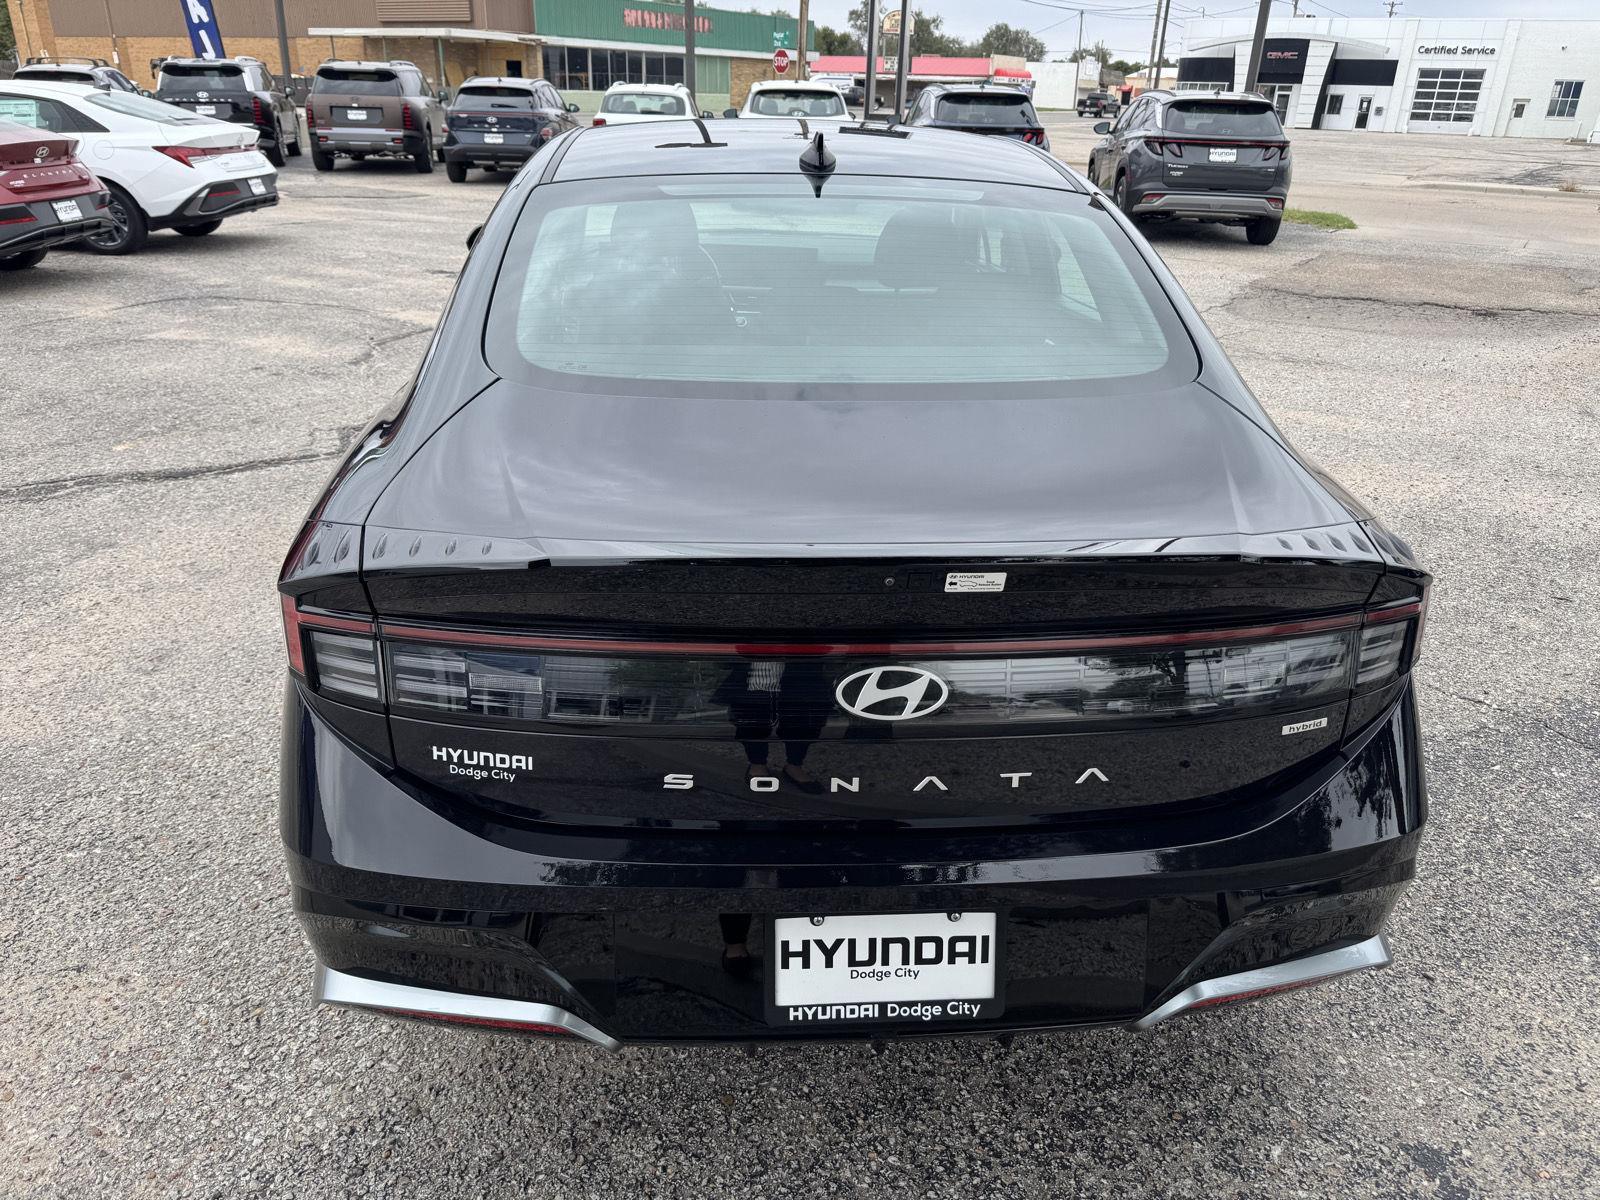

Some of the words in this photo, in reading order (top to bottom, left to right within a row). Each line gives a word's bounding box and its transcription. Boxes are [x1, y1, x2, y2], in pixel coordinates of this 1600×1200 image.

[1266, 51, 1298, 59] GMC
[1418, 45, 1458, 55] Certified
[1461, 46, 1496, 55] Service
[774, 56, 788, 66] STOP
[1288, 720, 1322, 733] hybrid
[432, 745, 533, 771] HYUNDAI
[449, 764, 489, 780] Dodge
[491, 769, 516, 782] City
[663, 767, 1109, 793] SONATA
[780, 935, 990, 970] HYUNDAI
[850, 969, 891, 981] Dodge
[895, 967, 920, 980] City
[789, 1004, 879, 1021] HYUNDAI
[887, 1002, 942, 1020] Dodge
[946, 1001, 981, 1017] City
